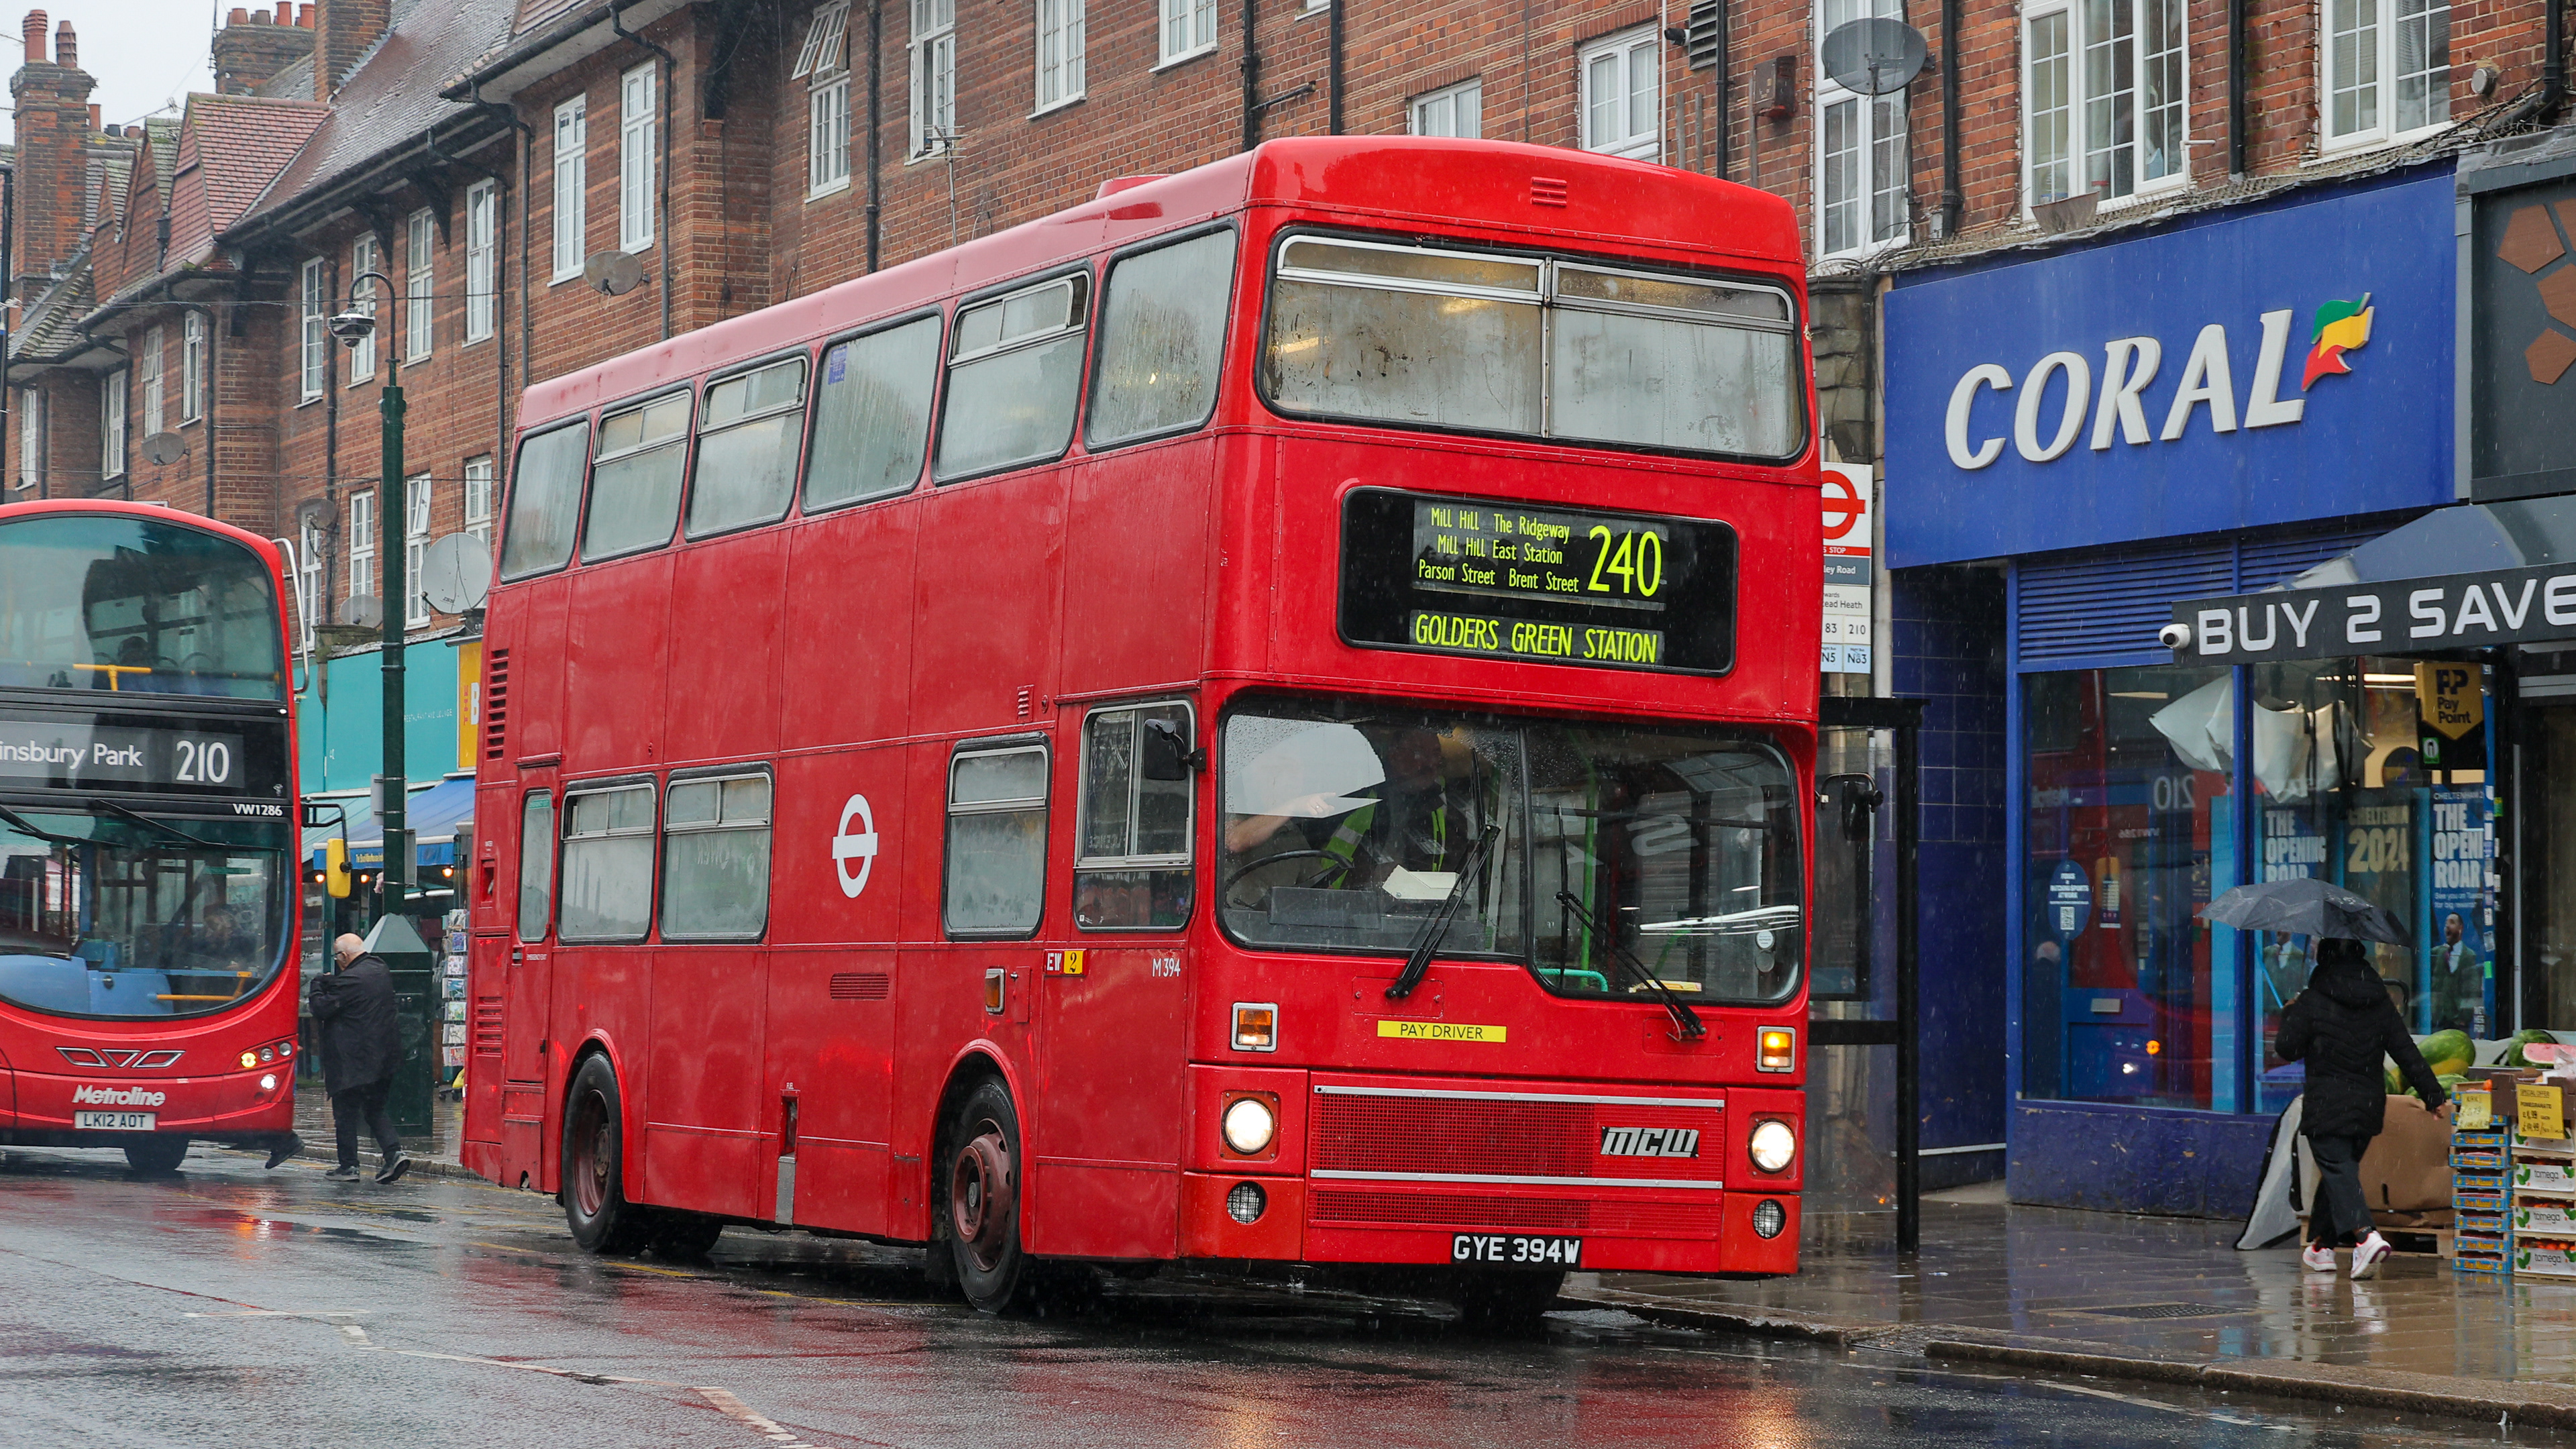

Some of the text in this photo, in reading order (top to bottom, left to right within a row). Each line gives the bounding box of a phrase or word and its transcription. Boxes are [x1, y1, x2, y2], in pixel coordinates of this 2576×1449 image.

[1945, 309, 2306, 470] CORAL
[1431, 508, 1570, 544] Mill Hill The Ridgeway
[1438, 535, 1562, 564] Mill Hill East Station
[1587, 525, 1662, 596] 240
[1419, 559, 1579, 593] Parson Street Brent Street
[1837, 566, 1856, 575] Road
[1840, 601, 1862, 609] Heath
[2198, 575, 2576, 655] BUY 2 SAVE
[1415, 614, 1657, 663] GOLDERS GREEN STATION
[1825, 623, 1866, 635] 83 210
[2437, 696, 2459, 712] Pay
[2438, 711, 2471, 724] Point
[93, 743, 144, 767] Park
[176, 741, 230, 784] 210
[233, 804, 283, 817] VW1286
[2265, 810, 2296, 836] THE
[2433, 803, 2467, 830] THE
[2265, 837, 2326, 863] OPENING
[2349, 828, 2410, 872] 2024
[2434, 860, 2480, 888] ROAR
[1046, 953, 1077, 973] EW 2
[1400, 1022, 1483, 1040] PAY DRIVER
[72, 1085, 166, 1106] Metroline
[84, 1114, 146, 1128] LK12 AOT
[2534, 1169, 2559, 1182] tamega
[2534, 1212, 2560, 1224] tamega
[1454, 1236, 1580, 1265] GYE 394W
[2534, 1253, 2561, 1266] tamega
